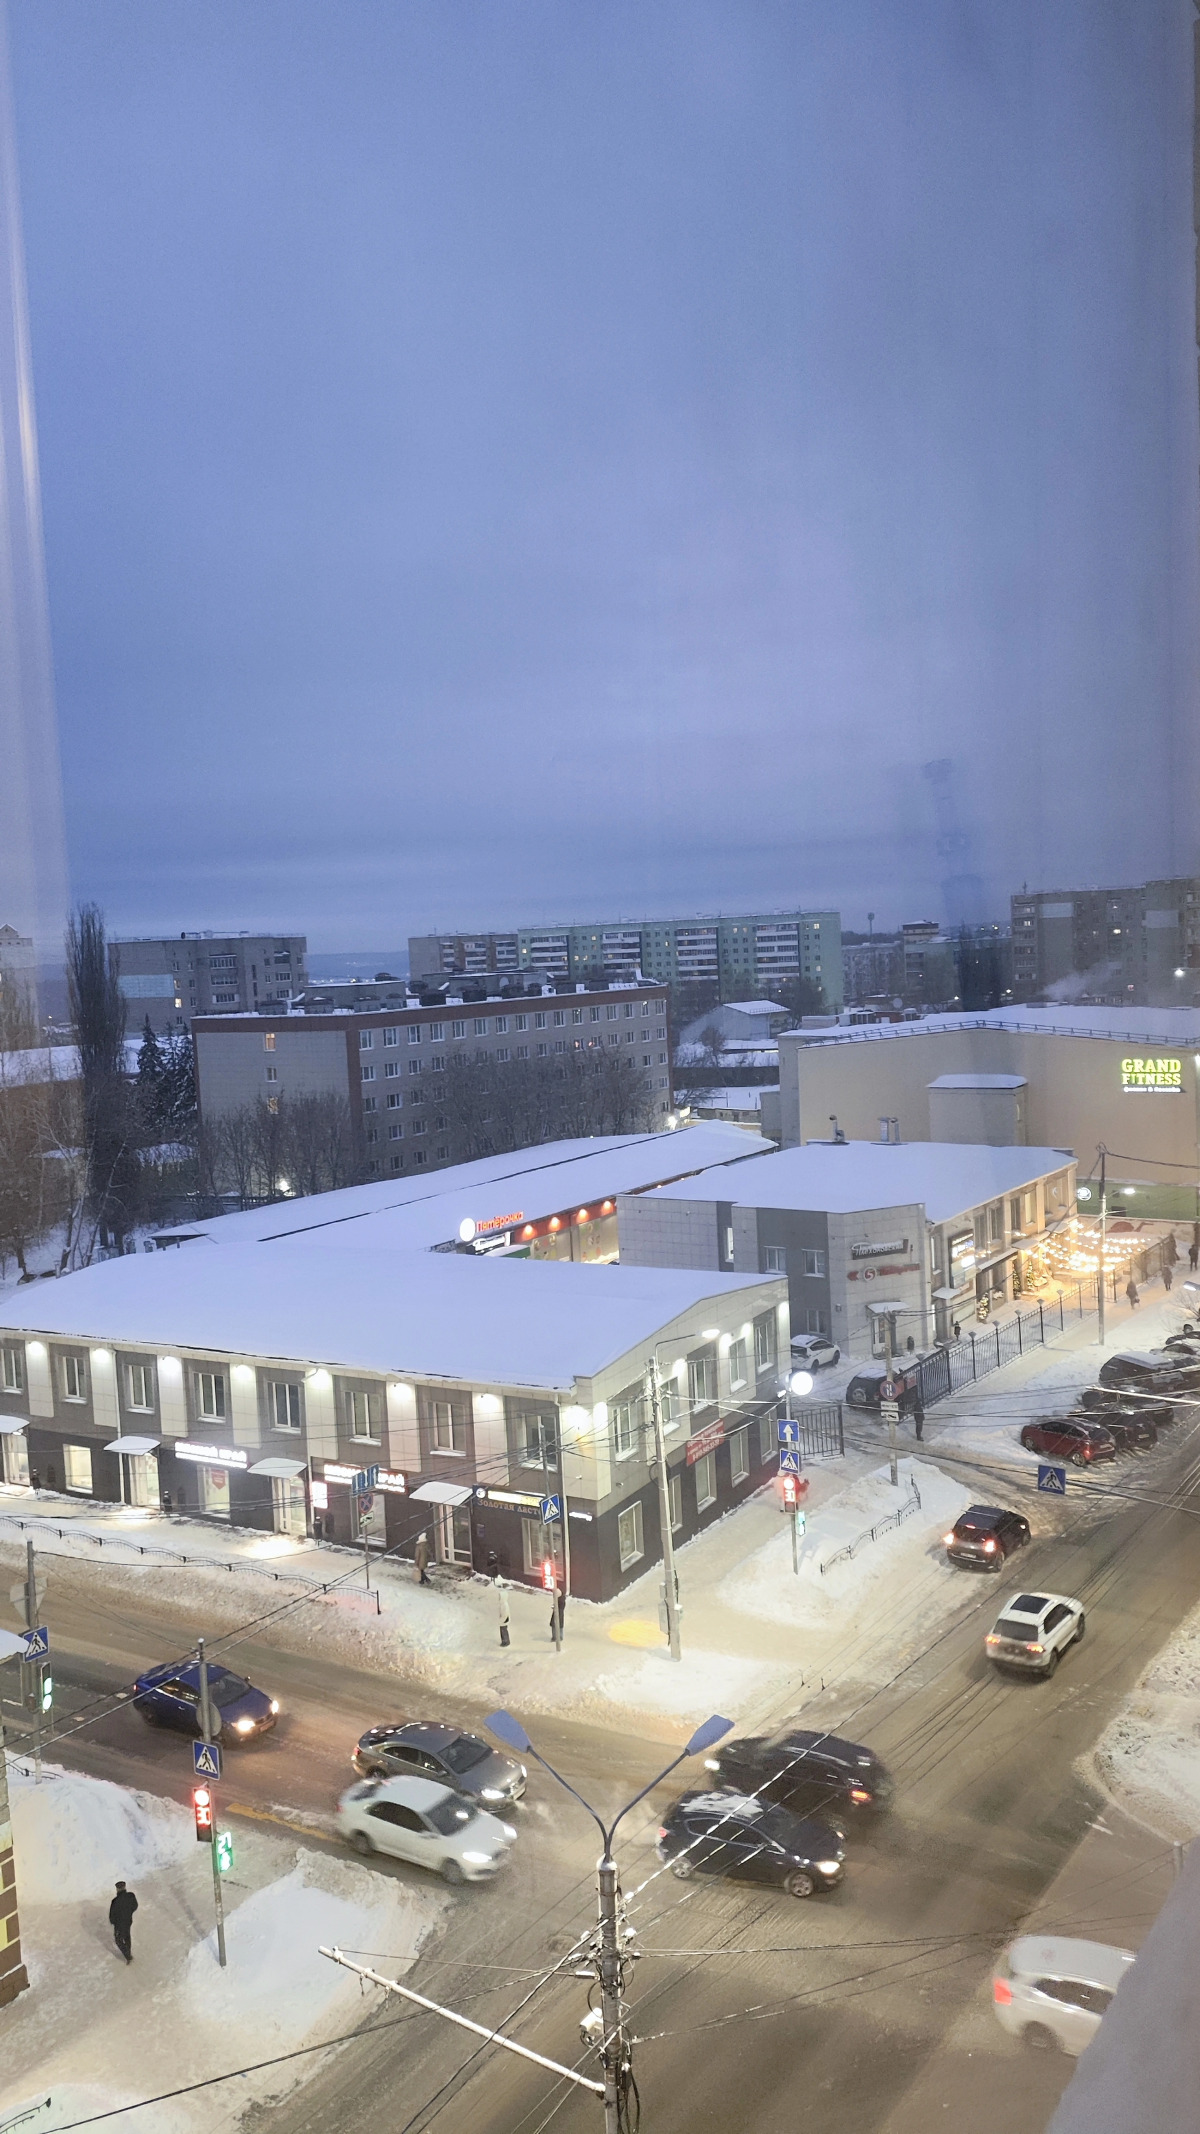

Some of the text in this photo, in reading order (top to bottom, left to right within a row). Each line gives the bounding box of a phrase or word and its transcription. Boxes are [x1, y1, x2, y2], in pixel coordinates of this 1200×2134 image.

[1121, 1058, 1181, 1072] GRAND
[1121, 1073, 1181, 1085] FITNESS
[476, 1211, 524, 1232] Пятёрочка
[378, 1472, 405, 1487] РАЙ
[785, 1490, 795, 1502] 30
[544, 1576, 554, 1589] 30
[196, 1807, 211, 1825] 30
